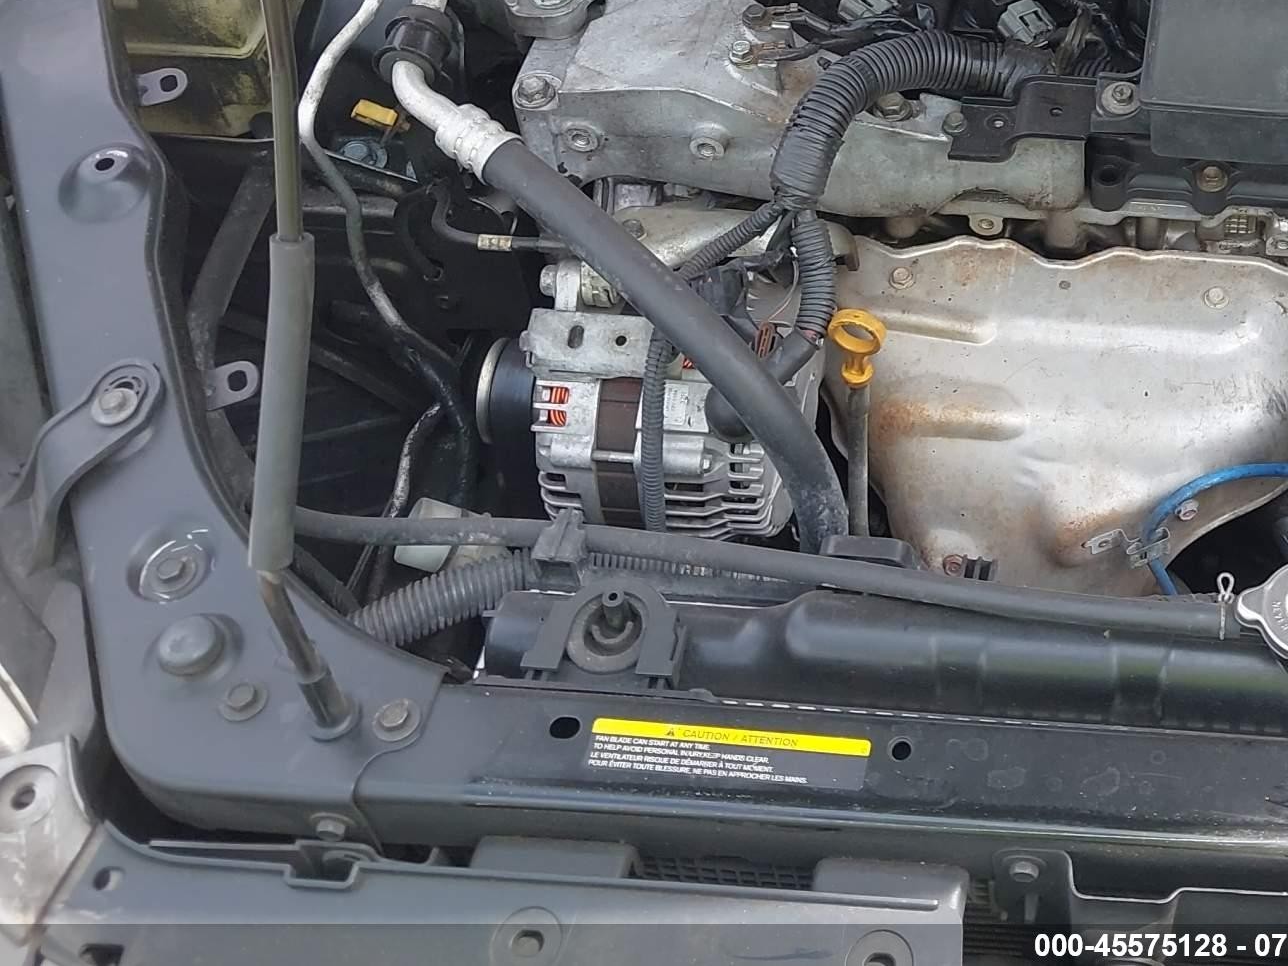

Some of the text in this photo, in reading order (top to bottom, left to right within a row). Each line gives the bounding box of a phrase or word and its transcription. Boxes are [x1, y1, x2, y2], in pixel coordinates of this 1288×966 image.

[610, 736, 632, 744] BLADE
[683, 728, 729, 741] CAUTION
[740, 734, 799, 747] ATTENTION
[644, 747, 678, 755] PERSONAL
[600, 752, 643, 762] VENTILATEUR
[644, 756, 668, 764] RISQUE
[681, 758, 717, 768] DÉMARRER
[588, 759, 608, 767] POUR
[609, 760, 632, 769] ÉVITER
[632, 763, 655, 771] TOUTE
[728, 771, 770, 780] APPROCHER
